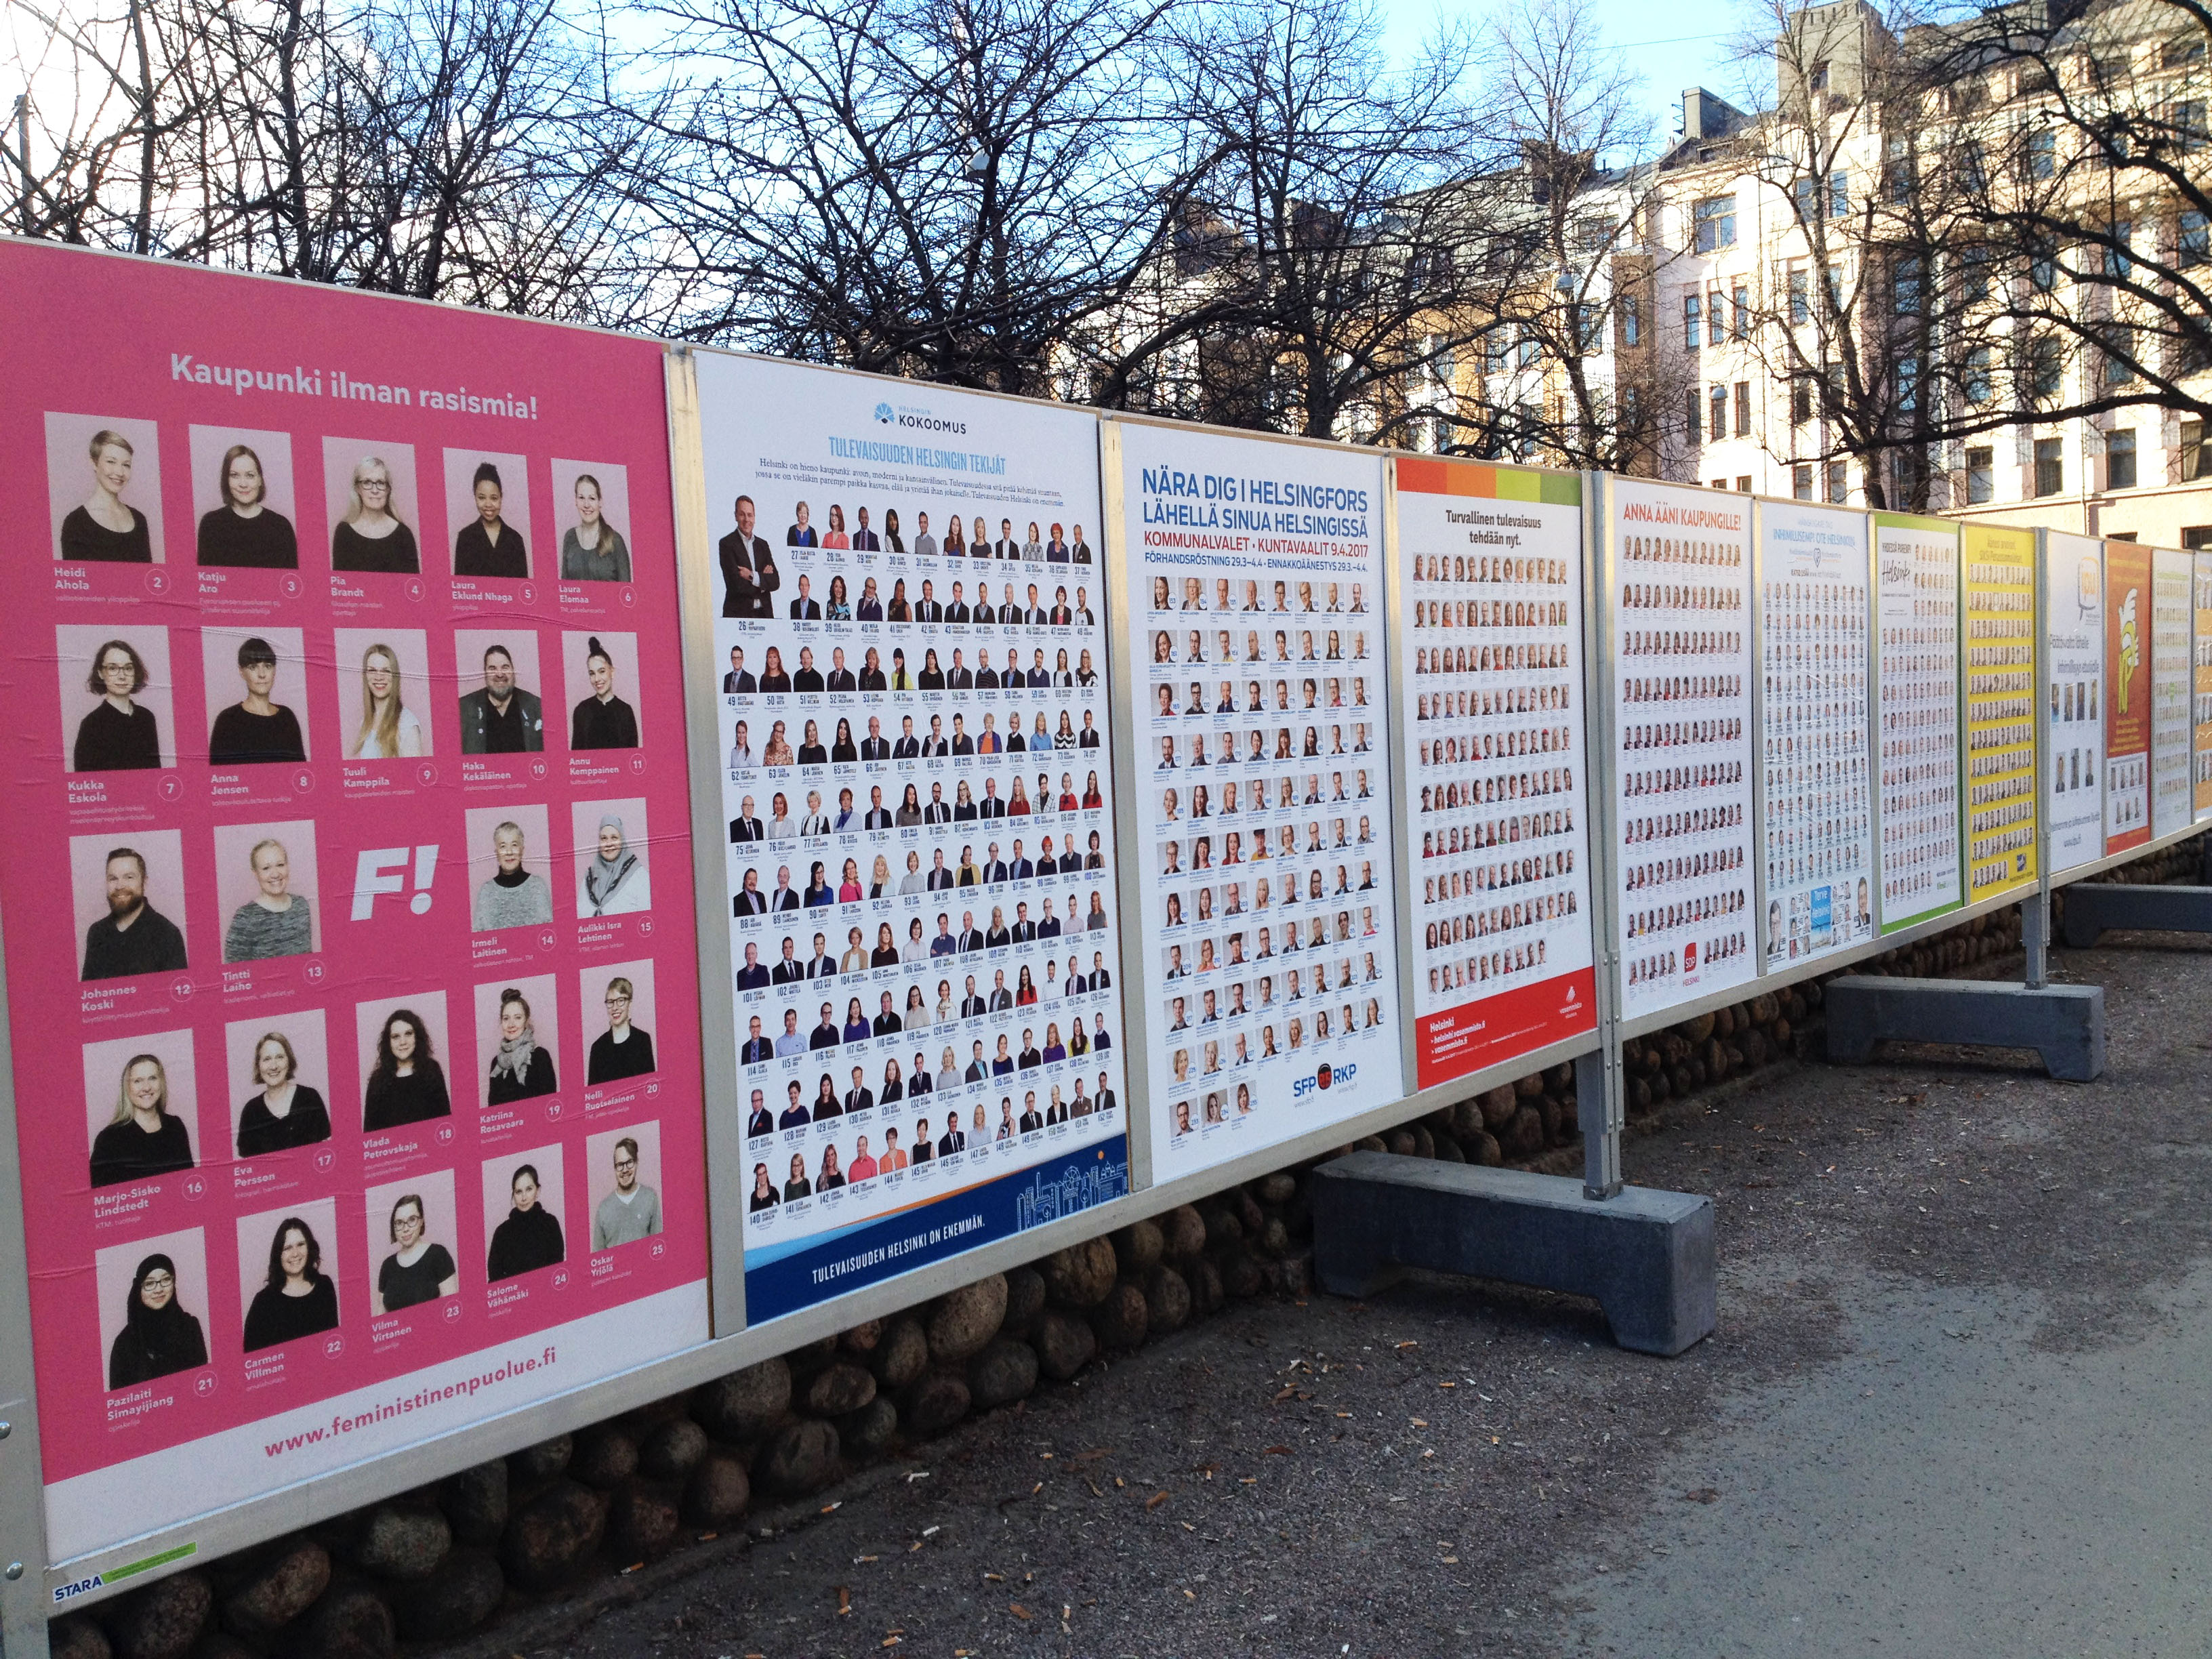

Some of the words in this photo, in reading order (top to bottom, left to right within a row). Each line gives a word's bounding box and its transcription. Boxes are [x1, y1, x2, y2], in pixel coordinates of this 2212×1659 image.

[171, 353, 321, 396] Kaupunki
[331, 371, 411, 405] ilman
[419, 387, 537, 420] rasismia!
[899, 415, 966, 434] KOKOOMUS
[829, 436, 914, 466] TULEVAISUUDEN
[916, 447, 967, 472] HELSINGIN
[970, 453, 1006, 475] TEKIJÄT
[760, 458, 787, 469] Helsinki
[800, 464, 818, 472] hieno
[872, 472, 897, 480] moderni
[756, 471, 772, 479] jossa
[794, 473, 818, 483] vieläkin
[820, 477, 846, 487] parempi
[848, 479, 867, 488] paikka
[931, 487, 943, 495] ihan
[1143, 465, 1200, 498] NÄRA
[1204, 475, 1235, 501] DIG
[1242, 479, 1245, 502] I
[1250, 480, 1368, 512] HELSINGFORS
[1144, 498, 1218, 529] LÄHELLÄ
[1223, 508, 1271, 531] SINUA
[1275, 513, 1368, 538] HELSINGISSÄ
[1446, 510, 1495, 525] Turvallinen
[1496, 513, 1541, 529] tulevaisuus
[1624, 504, 1652, 521] ANNA
[1655, 501, 1678, 525] ÄÄNI
[1681, 508, 1741, 531] KAUPUNGILLE!
[1470, 530, 1504, 545] tehdään
[1506, 534, 1521, 546] nyt.
[1145, 531, 1250, 552] KOMMUNALVALET
[1258, 538, 1329, 556] KUNTAVAALIT
[1331, 544, 1368, 558] 9.4.2017
[1145, 551, 1230, 567] FÖRHANDSRÖSTNING
[1267, 558, 1336, 571] ENNAKKOÄÄNESTYS
[54, 567, 85, 577] Heidi
[153, 577, 161, 588] 2
[198, 572, 226, 584] Katju
[330, 577, 346, 586] Pia
[55, 579, 89, 590] Ahola
[199, 583, 218, 594] Aro
[287, 581, 295, 592] 3
[451, 581, 476, 590] Laura
[331, 588, 364, 597] Brandt
[411, 586, 419, 595] 4
[525, 589, 531, 598] 5
[452, 591, 483, 601] Eklund
[485, 592, 512, 602] Nhaga
[560, 595, 588, 604] Elomaa
[625, 593, 631, 602] 6
[739, 621, 746, 630] 26
[462, 762, 485, 771] Haka
[569, 757, 590, 766] Annu
[633, 760, 642, 769] 11
[343, 766, 367, 777] Tuuli
[533, 764, 544, 774] 10
[570, 765, 619, 776] Kemppainen
[211, 774, 239, 783] Anna
[424, 770, 430, 780] 9
[464, 770, 511, 781] Kekäläinen
[68, 781, 104, 791] Kukka
[300, 777, 307, 787] 8
[344, 776, 390, 790] Kamppila
[166, 783, 174, 794] 7
[211, 785, 249, 795] Jensen
[68, 792, 106, 803] Eskola
[350, 844, 440, 922] F!
[578, 922, 606, 935] Aulikki
[607, 921, 621, 930] Isra
[641, 923, 651, 932] 15
[472, 938, 497, 948] Irmeli
[541, 936, 553, 945] 14
[579, 933, 612, 944] Lehtinen
[472, 947, 507, 958] Laitinen
[1685, 956, 1696, 968] SDP
[222, 970, 251, 981] Tintti
[308, 967, 322, 977] 13
[81, 985, 136, 1000] Johannes
[176, 984, 190, 995] 12
[223, 981, 251, 993] Laiho
[81, 999, 114, 1012] Koski
[1430, 1017, 1454, 1033] Helsinki
[1435, 1036, 1468, 1054] vasemmisto.fi
[1293, 1076, 1317, 1098] SFP
[1333, 1063, 1357, 1084] RKP
[647, 1084, 657, 1093] 20
[585, 1090, 603, 1101] Nelli
[586, 1094, 635, 1111] Ruotsalainen
[549, 1105, 560, 1115] 19
[480, 1110, 514, 1124] Katriina
[480, 1118, 523, 1134] Rosavaara
[439, 1129, 451, 1139] 18
[784, 1130, 794, 1141] 128
[363, 1137, 390, 1149] Vlada
[364, 1141, 418, 1160] Petrovskaja
[318, 1155, 331, 1166] 17
[234, 1166, 252, 1176] Eva
[234, 1173, 275, 1188] Persson
[187, 1182, 202, 1193] 16
[94, 1185, 161, 1208] Marjo-Sisko
[94, 1200, 149, 1218] Lindstedt
[750, 1214, 760, 1225] 140
[652, 1245, 663, 1255] 25
[813, 1248, 885, 1284] TULEVAISUUDEN
[888, 1235, 927, 1258] HELSINKI
[929, 1229, 941, 1246] ON
[943, 1215, 985, 1240] ENEMMÄN.
[590, 1255, 613, 1267] Oskar
[591, 1264, 613, 1277] Yrjölä
[554, 1274, 566, 1284] 24
[487, 1284, 518, 1298] Salome
[487, 1289, 529, 1309] Vähämäki
[446, 1307, 459, 1317] 23
[372, 1318, 398, 1332] Vilma
[372, 1325, 412, 1342] Virtanen
[327, 1341, 340, 1353] 22
[245, 1352, 285, 1369] Carmen
[245, 1362, 285, 1380] Villman
[198, 1378, 213, 1390] 21
[107, 1388, 152, 1408] Pazilaiti
[265, 1346, 557, 1457] www.feministinenpuolue.fi
[107, 1395, 173, 1420] Simayijiang
[55, 1576, 102, 1601] STARA
